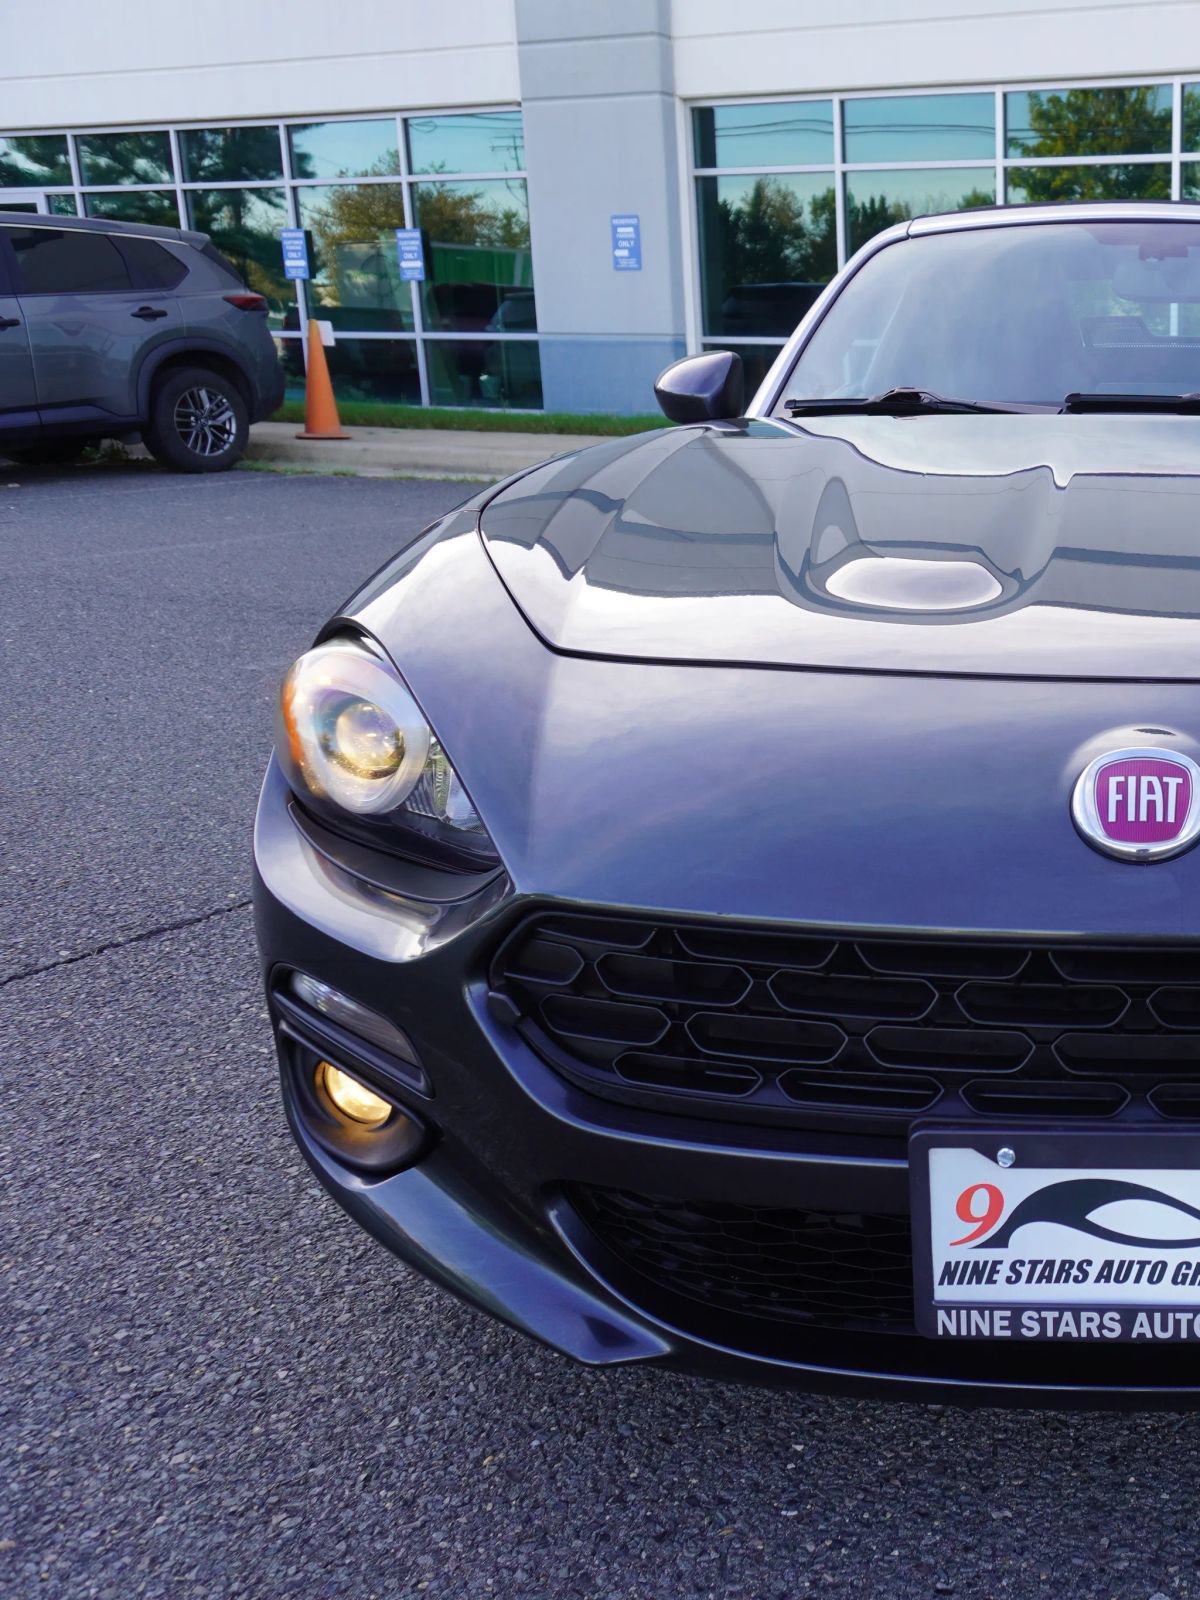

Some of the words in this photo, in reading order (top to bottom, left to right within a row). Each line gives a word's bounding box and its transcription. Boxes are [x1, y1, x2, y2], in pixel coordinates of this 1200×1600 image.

[617, 239, 635, 248] ONLY
[1107, 775, 1184, 823] FIAT
[949, 1183, 1005, 1246] 9
[938, 1259, 1003, 1286] NINE
[1005, 1259, 1093, 1285] STARS
[1094, 1259, 1168, 1285] AUTO
[936, 1309, 1012, 1336] NINE
[1020, 1311, 1122, 1339] STARS
